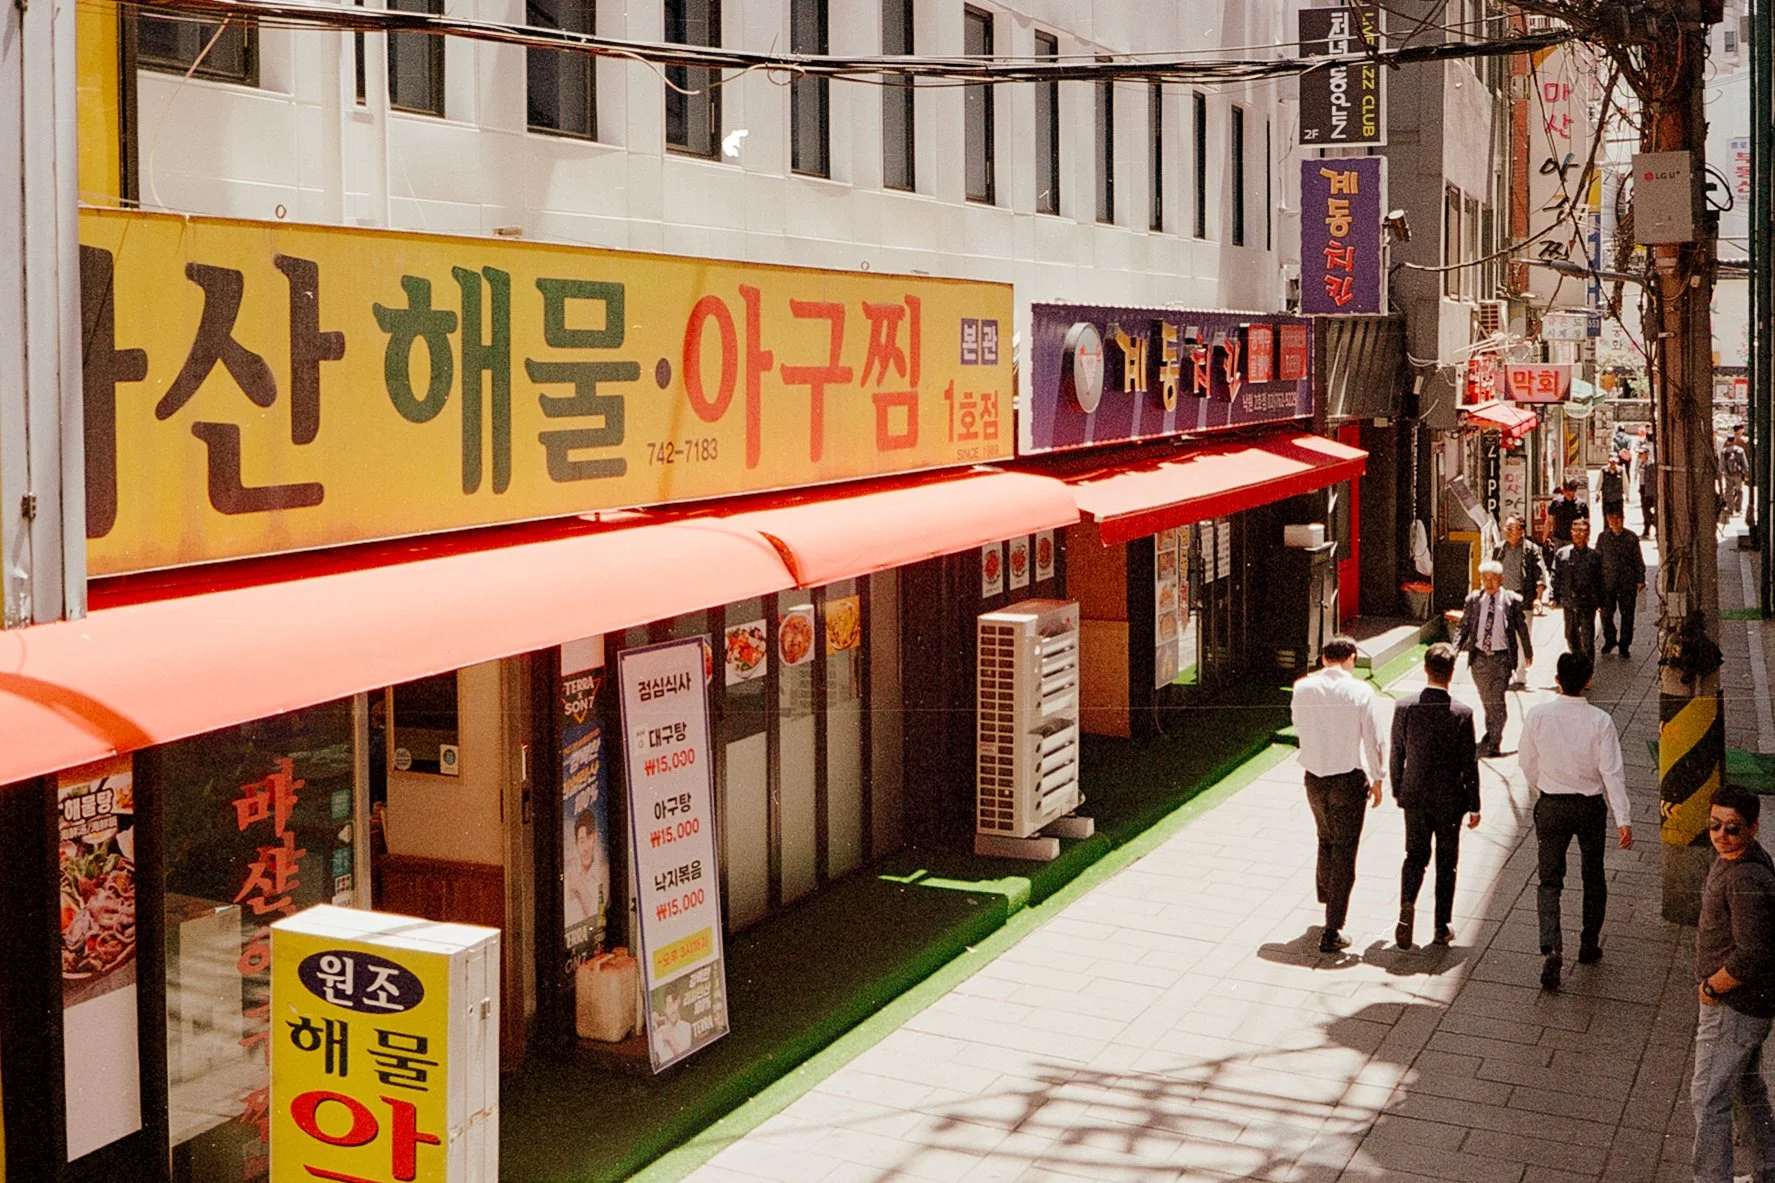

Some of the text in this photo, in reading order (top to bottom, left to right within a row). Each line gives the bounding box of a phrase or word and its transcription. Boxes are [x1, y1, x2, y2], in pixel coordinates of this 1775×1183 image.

[1362, 95, 1375, 137] CLUB
[1543, 82, 1574, 140] 마산
[1304, 129, 1319, 140] 2F
[962, 323, 997, 361] 본관
[1513, 370, 1559, 397] 막회
[944, 379, 998, 442] 1호점
[647, 438, 718, 466] 742-7183
[957, 447, 979, 460] SINCE
[563, 676, 595, 697] TERRA
[638, 672, 692, 701] 점심식사
[564, 695, 596, 716] SON7
[649, 721, 687, 748] 대구탕
[644, 748, 695, 776] ₩15,000
[64, 788, 112, 821] 해물탕
[654, 792, 692, 820] 아구탕
[650, 817, 700, 849] ₩15,000
[654, 859, 702, 892] 낙지볶음
[656, 888, 705, 922] ₩15,000
[316, 954, 405, 1013] 원조
[286, 1014, 440, 1093] 해물
